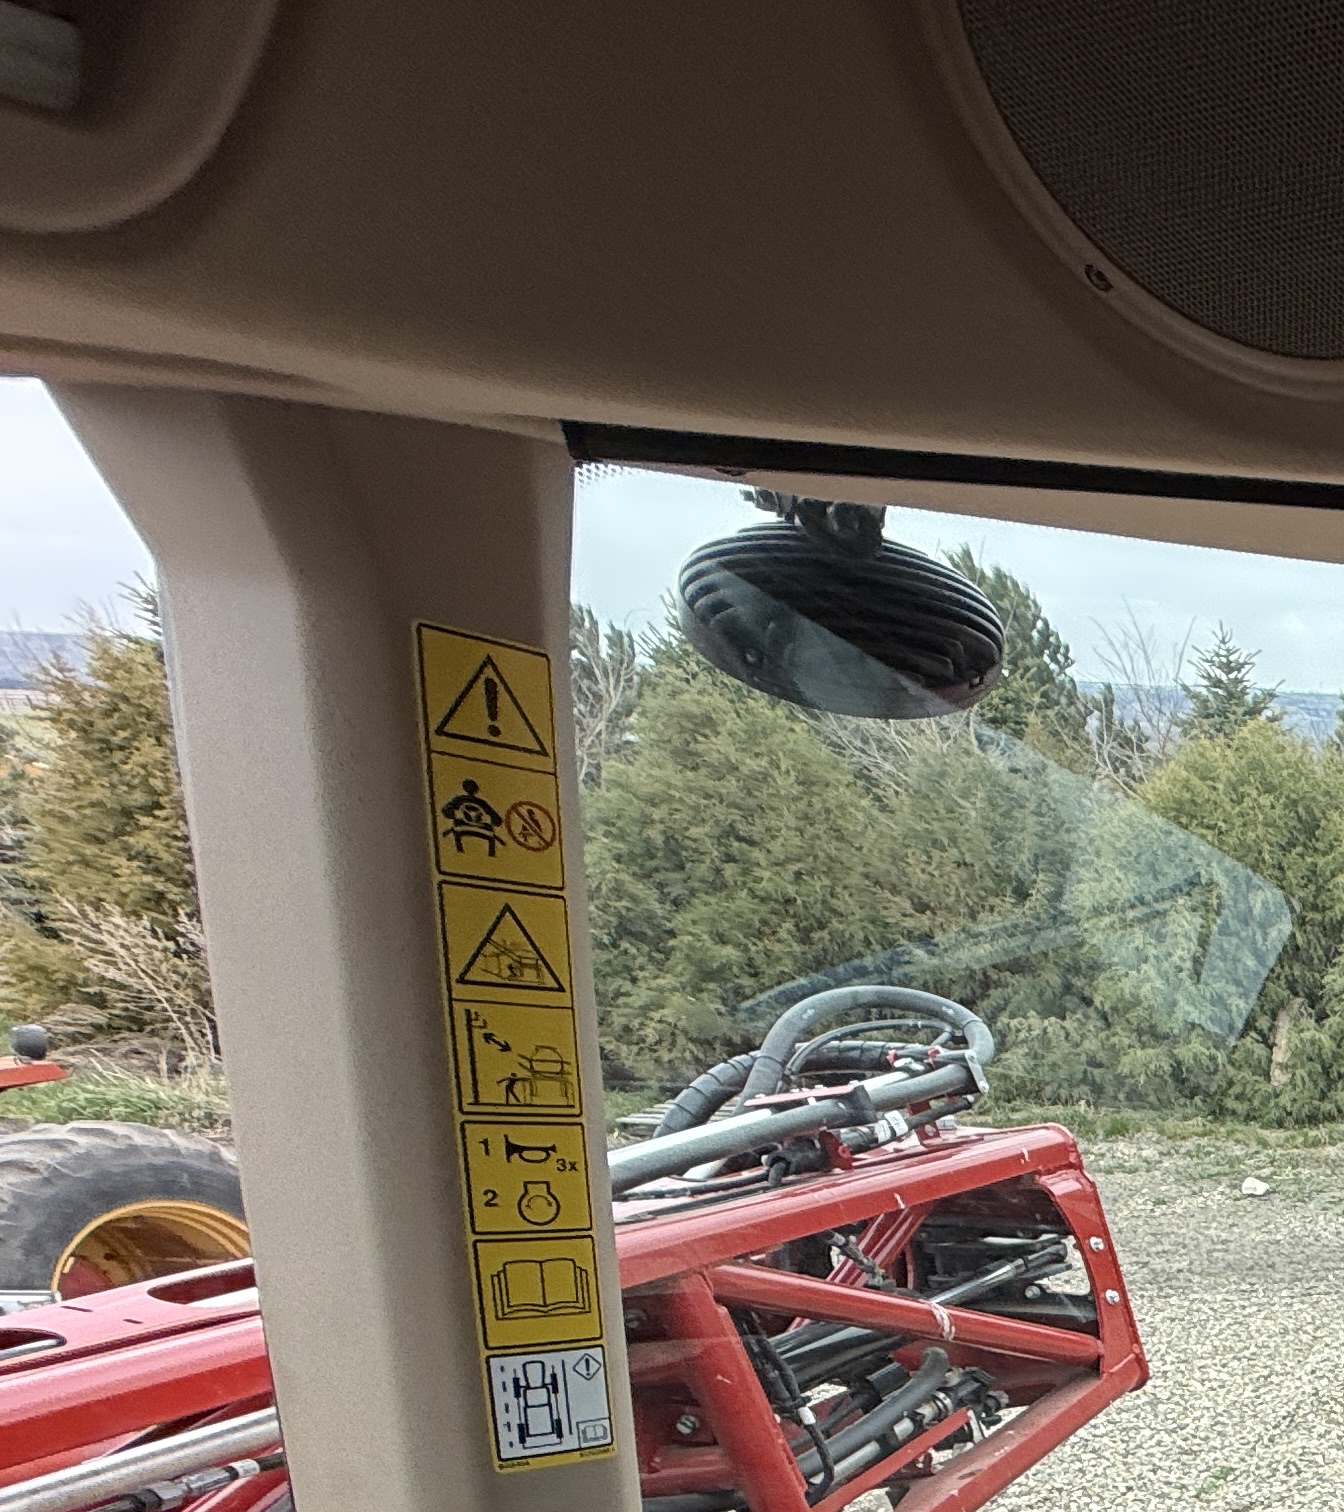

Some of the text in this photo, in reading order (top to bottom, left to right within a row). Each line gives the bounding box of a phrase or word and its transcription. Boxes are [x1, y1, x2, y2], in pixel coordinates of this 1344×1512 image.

[478, 1137, 490, 1156] 1
[556, 1158, 579, 1172] 3x
[483, 1188, 500, 1207] 2
